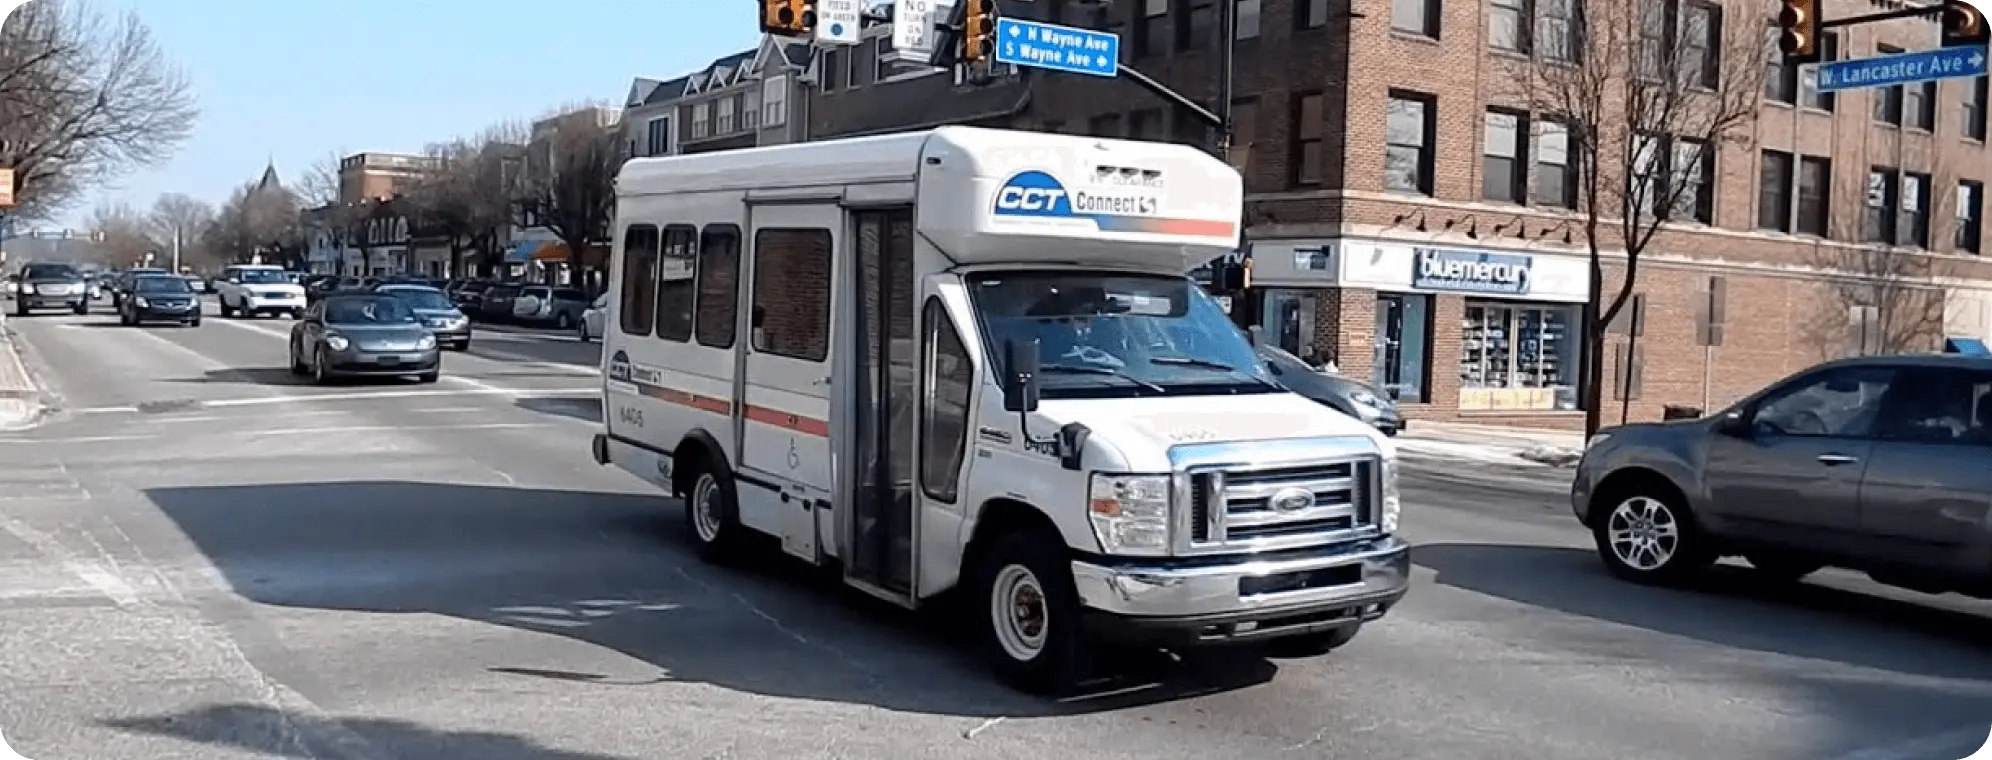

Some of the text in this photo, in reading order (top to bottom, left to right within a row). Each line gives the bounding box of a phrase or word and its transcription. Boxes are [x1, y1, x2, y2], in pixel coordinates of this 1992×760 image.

[904, 0, 926, 12] NO
[1041, 28, 1082, 49] Wayne
[1085, 34, 1109, 52] Ave
[1005, 40, 1091, 67] S Wayne Ave
[1842, 61, 1924, 83] Lancaster
[1929, 55, 1963, 74] Ave
[998, 186, 1066, 211] CCT
[1076, 192, 1135, 212] Connect
[1420, 247, 1530, 291] bluemercury
